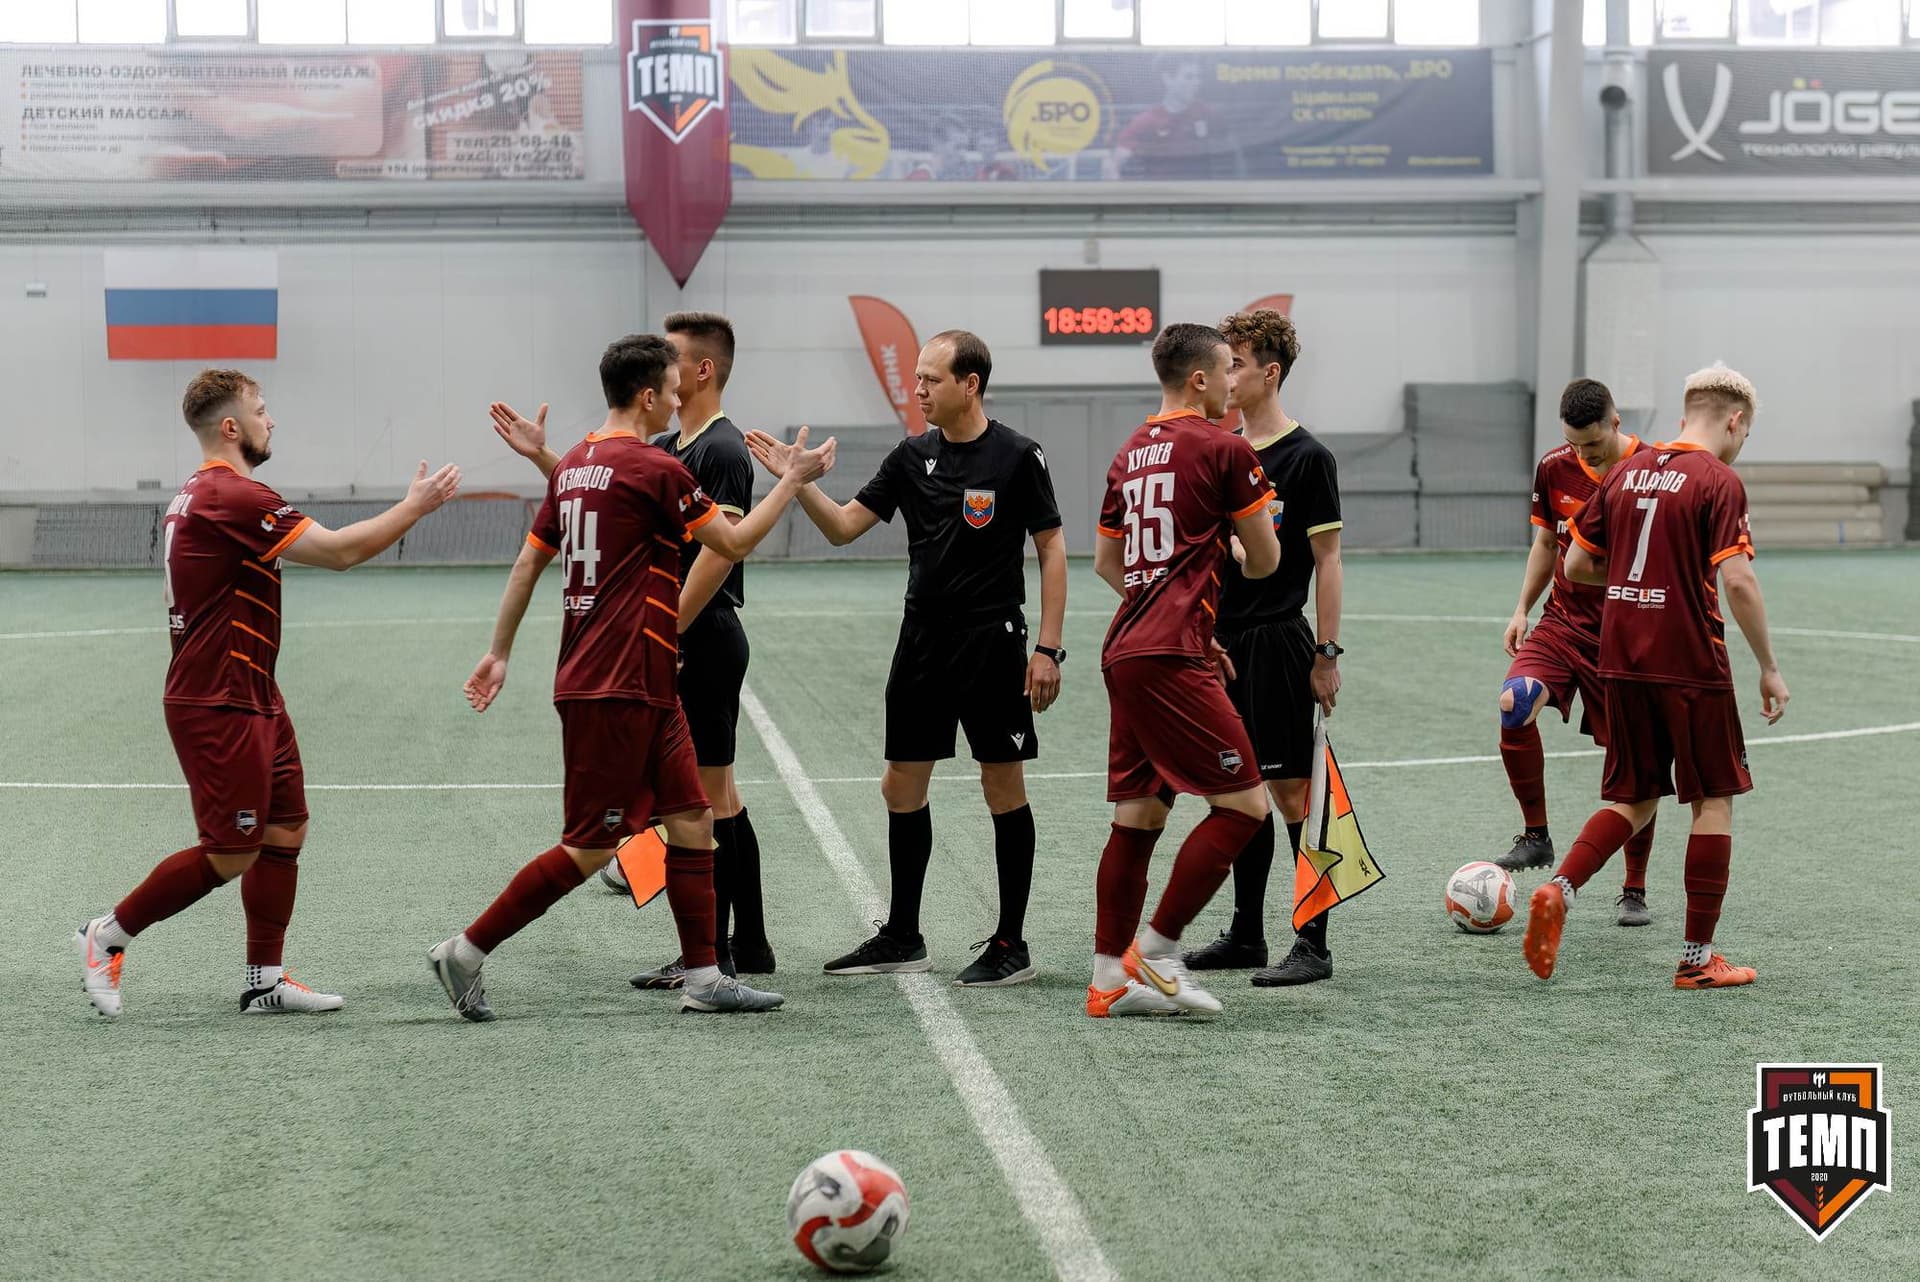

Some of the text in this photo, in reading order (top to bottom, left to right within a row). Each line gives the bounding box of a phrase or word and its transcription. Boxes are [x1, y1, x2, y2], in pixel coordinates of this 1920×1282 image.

[500, 70, 552, 103] 20%
[637, 54, 715, 97] ТЕМП
[21, 106, 104, 121] ДЕТСКИЙ
[1031, 102, 1090, 123] .БРО
[1044, 307, 1153, 334] 18:59:33
[1127, 442, 1174, 473] ХУГАЕВ
[1622, 469, 1687, 493] ЖДАНОВ
[559, 497, 601, 590] 24
[1627, 497, 1659, 582] 7
[1608, 585, 1666, 603] SEUS
